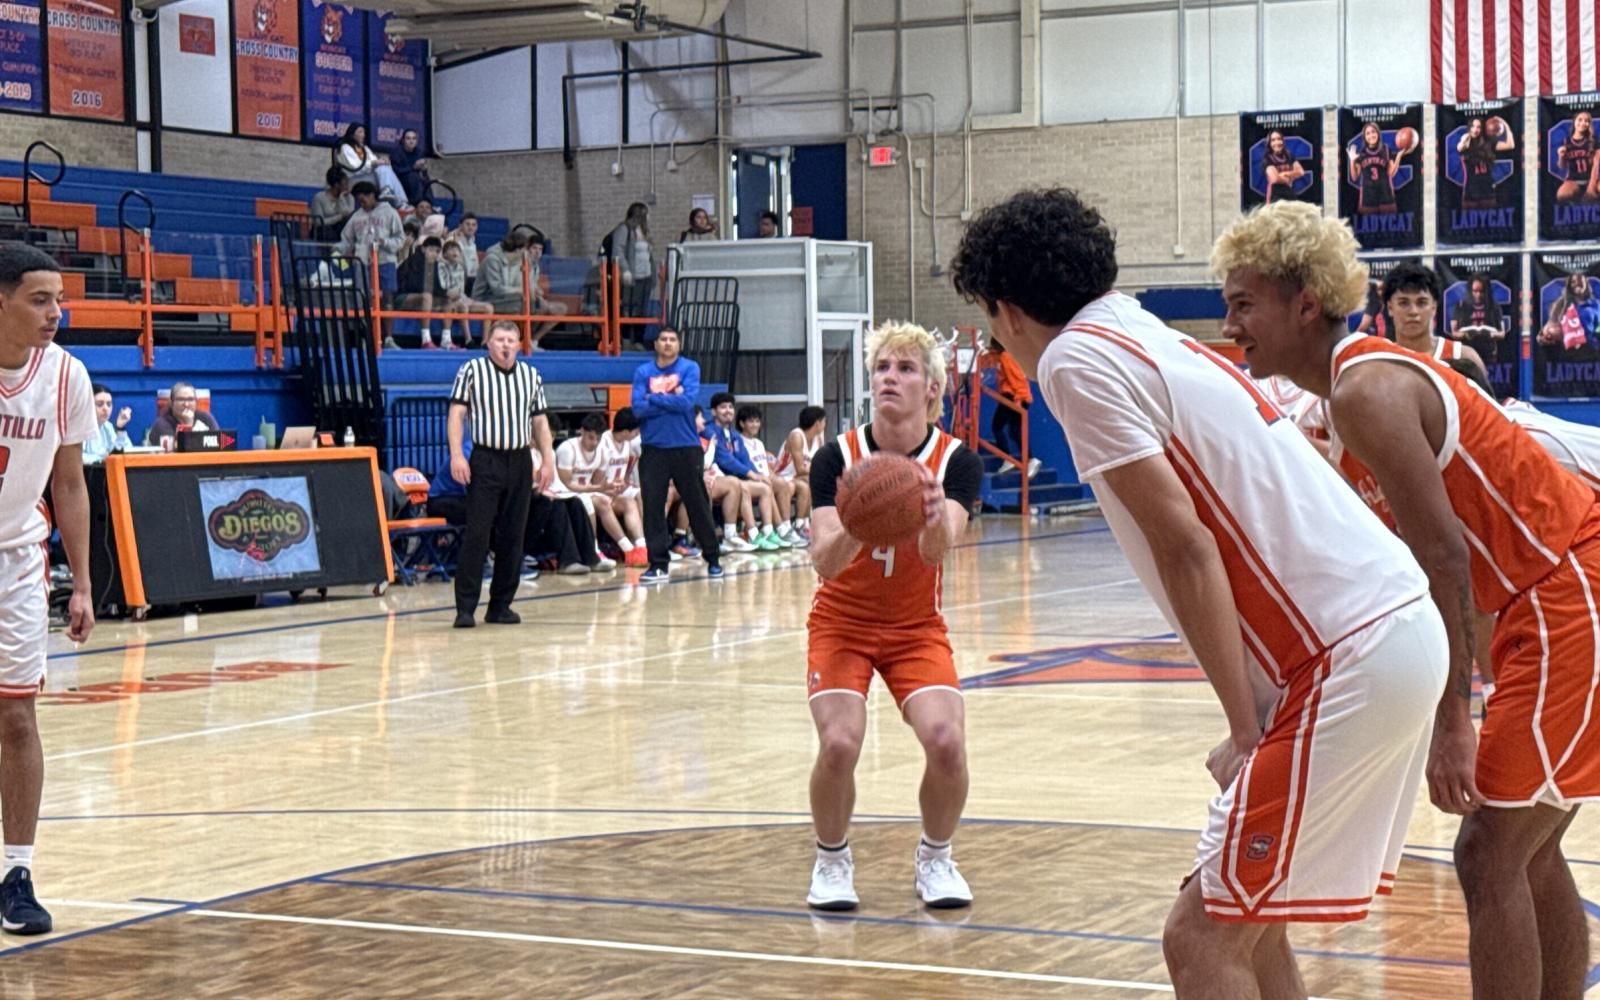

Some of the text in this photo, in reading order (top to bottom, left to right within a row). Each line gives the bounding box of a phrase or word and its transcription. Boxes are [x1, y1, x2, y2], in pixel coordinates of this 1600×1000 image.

[0, 3, 40, 25] OUNTRY
[79, 15, 121, 35] COUNTRY
[262, 43, 298, 63] COUNTRY
[72, 89, 102, 108] 2016
[256, 112, 281, 134] 2017
[1354, 213, 1415, 233] LADYCAT
[1451, 207, 1516, 230] LADYCAT
[0, 414, 46, 440] TILLO
[871, 543, 896, 578] 4
